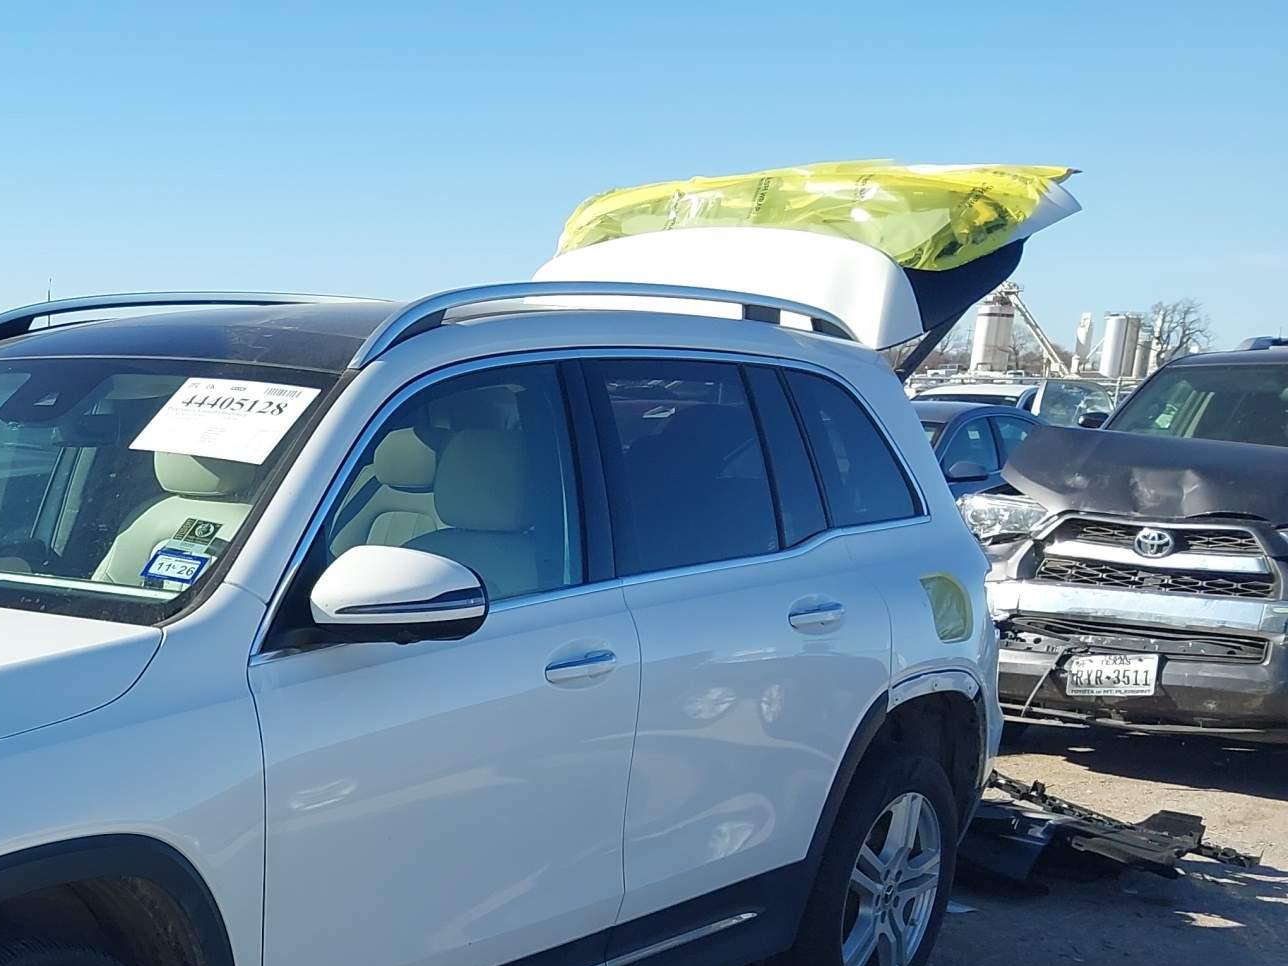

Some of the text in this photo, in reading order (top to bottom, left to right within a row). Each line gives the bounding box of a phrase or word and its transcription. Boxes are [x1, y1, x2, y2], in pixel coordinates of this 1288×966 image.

[181, 394, 288, 416] 44405128
[176, 565, 195, 576] 26
[1113, 669, 1150, 686] 3511
